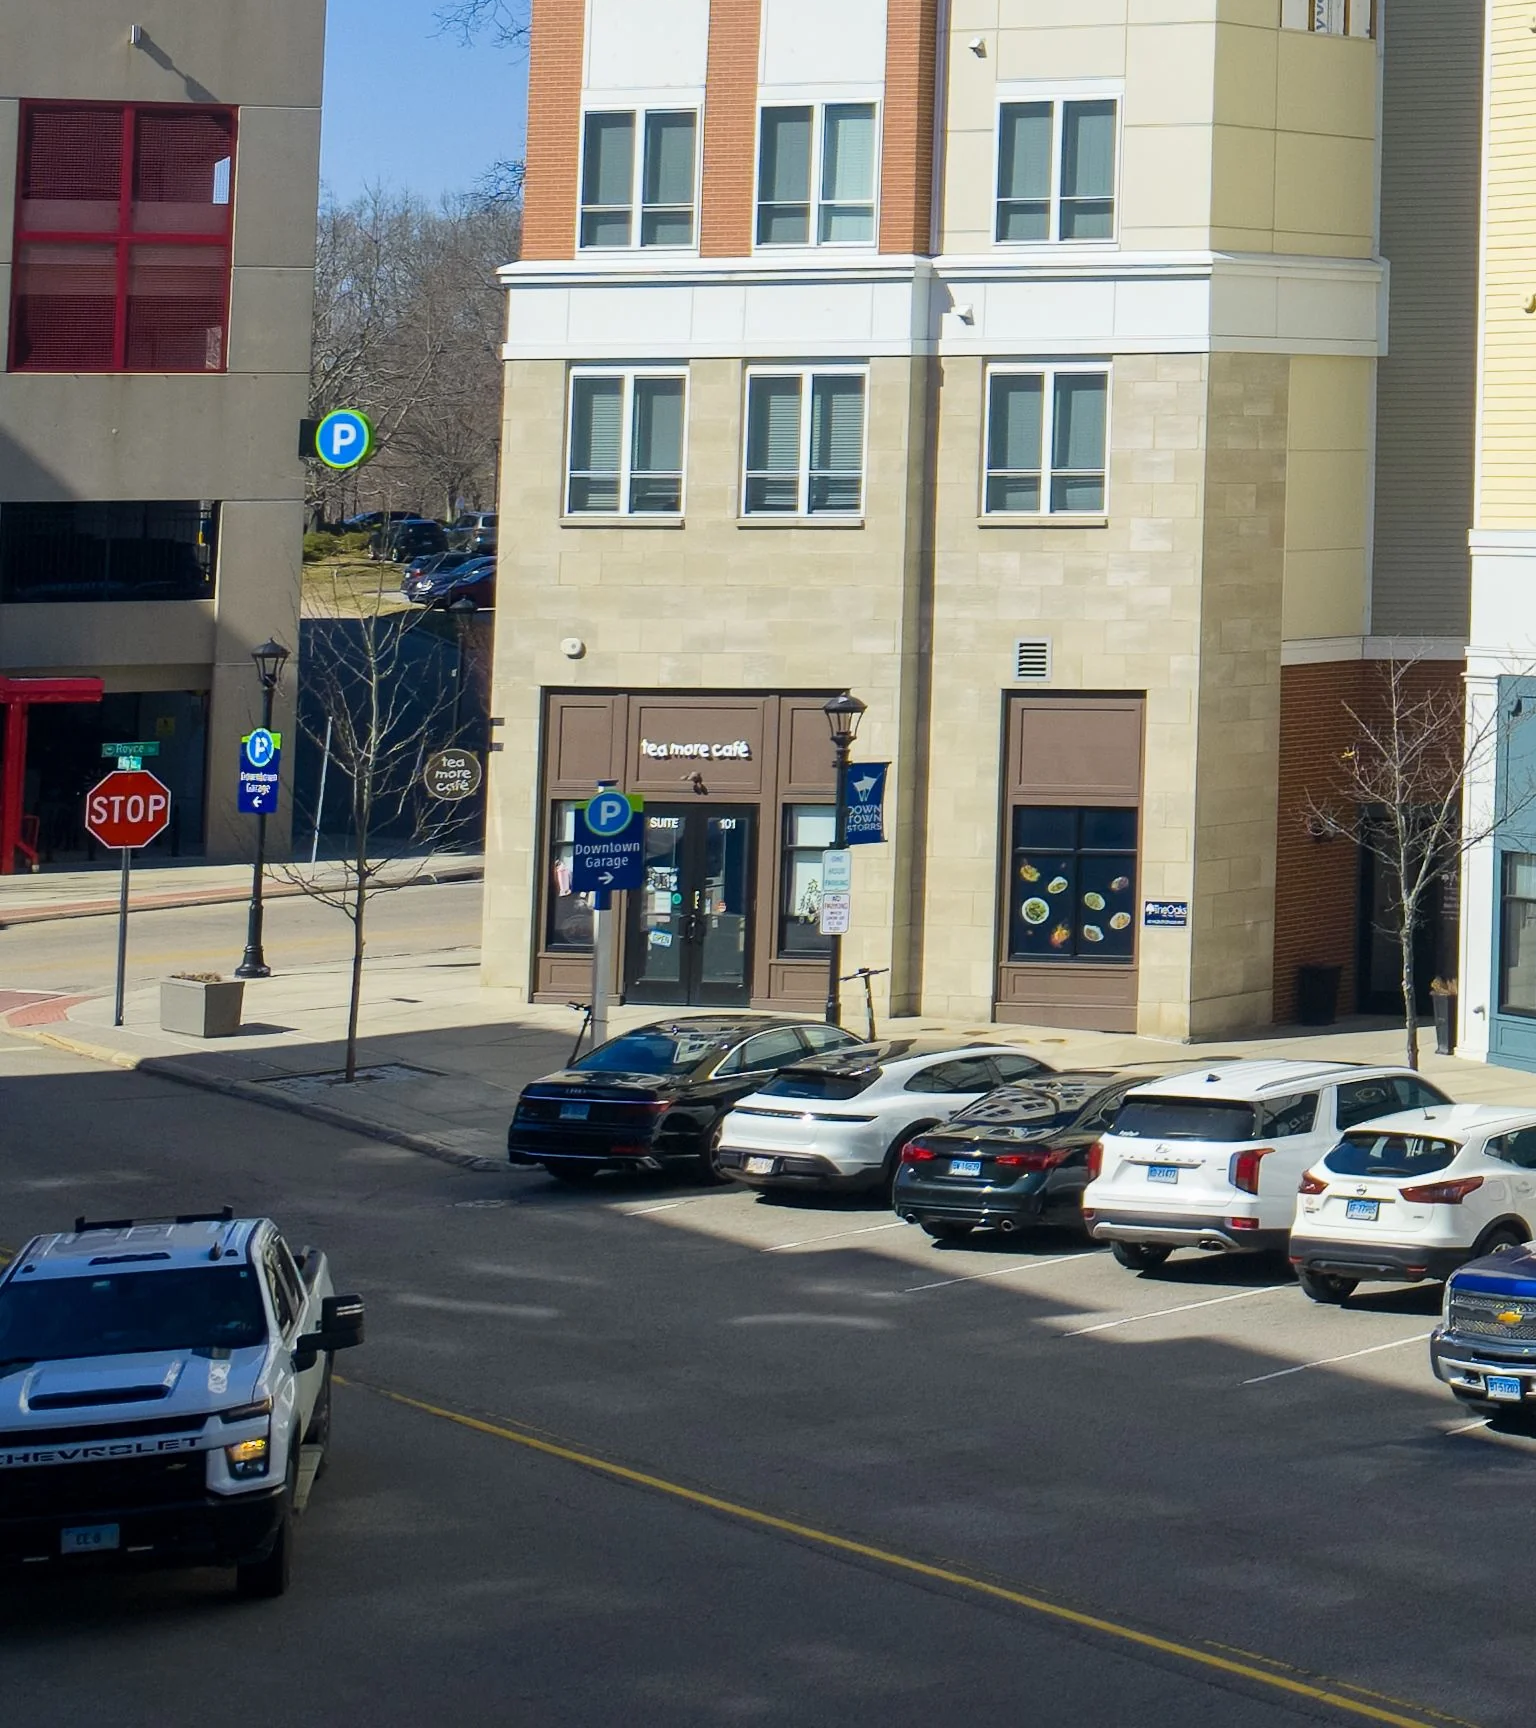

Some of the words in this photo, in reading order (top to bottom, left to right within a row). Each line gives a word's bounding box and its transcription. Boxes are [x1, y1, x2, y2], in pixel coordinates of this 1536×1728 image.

[332, 422, 357, 456] P
[116, 744, 144, 755] Royce
[641, 738, 668, 758] tea
[669, 742, 710, 758] more
[711, 740, 749, 759] café
[442, 756, 465, 768] tea
[434, 769, 472, 779] more
[436, 779, 469, 792] café
[90, 794, 166, 825] STOP
[600, 800, 621, 825] P
[650, 817, 679, 829] SUITE
[719, 819, 736, 830] 101
[575, 841, 640, 855] Downtown
[585, 855, 629, 869] Garage
